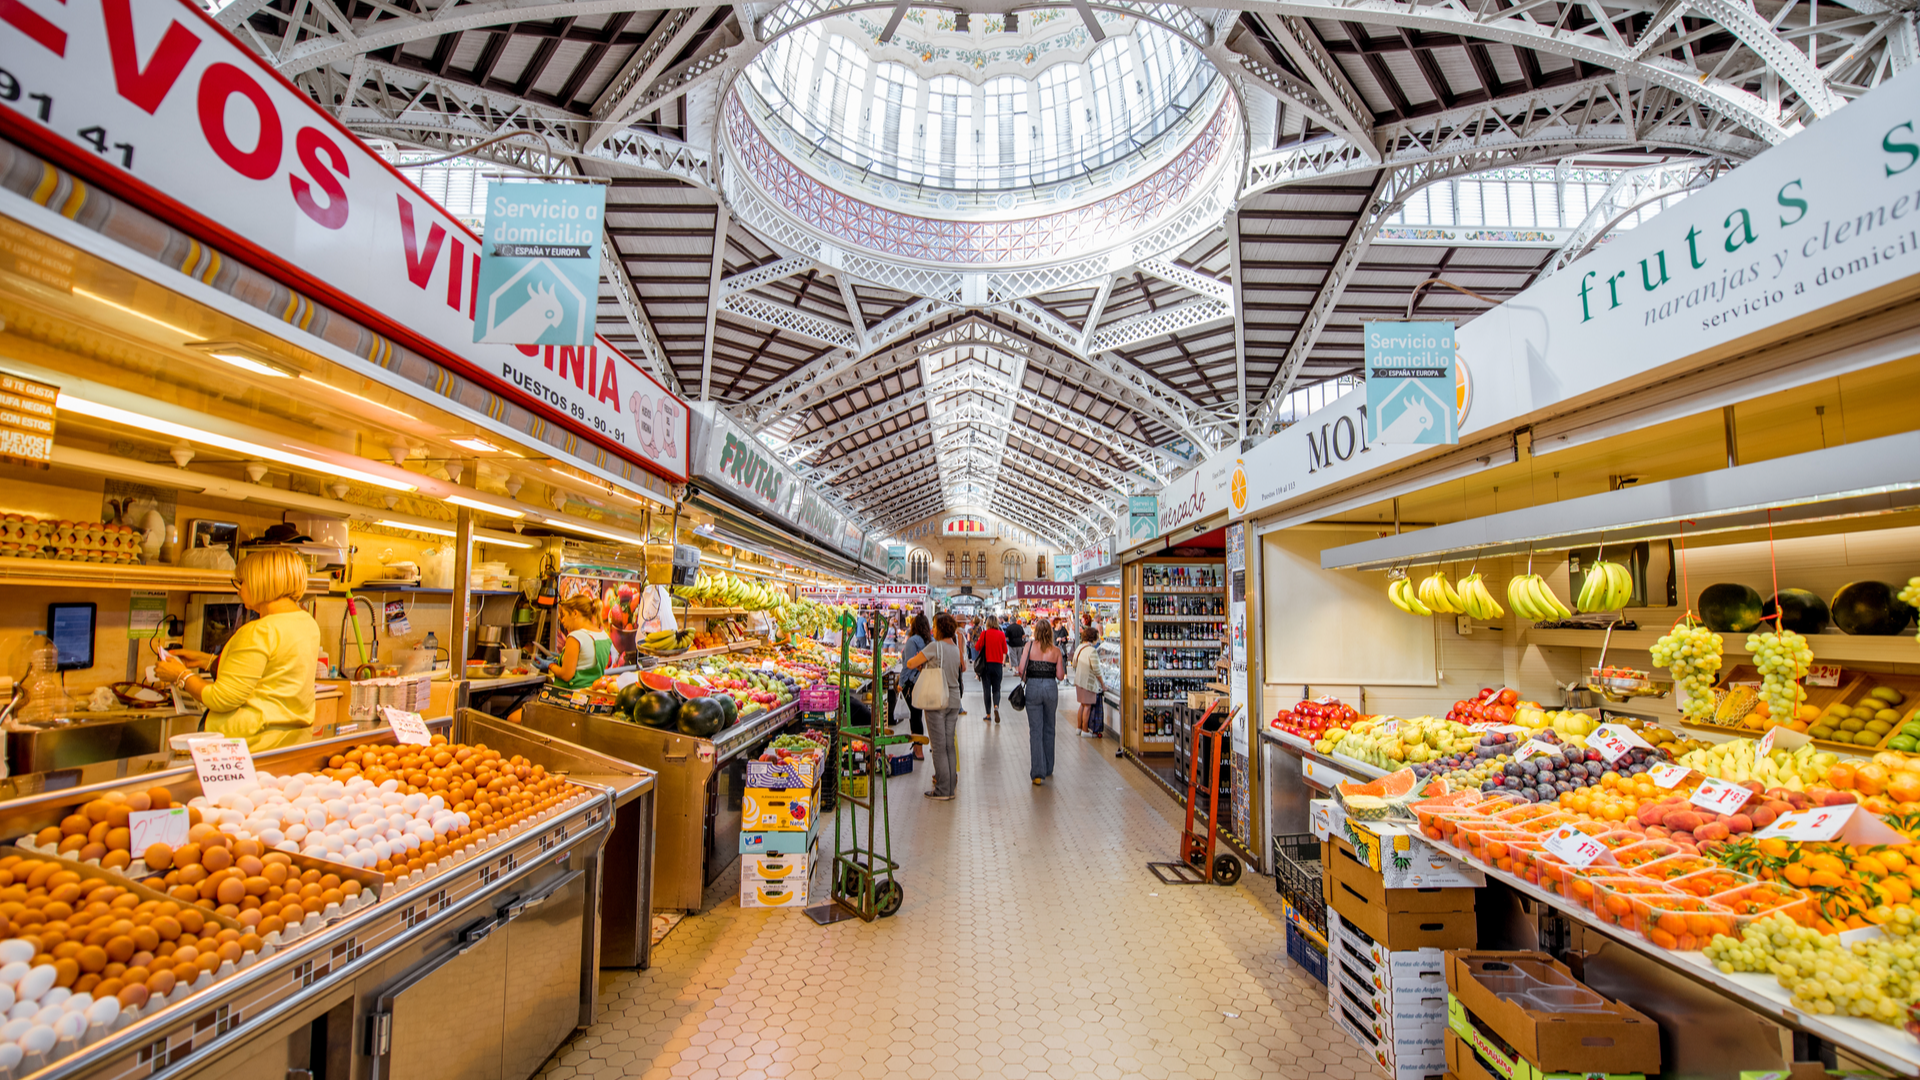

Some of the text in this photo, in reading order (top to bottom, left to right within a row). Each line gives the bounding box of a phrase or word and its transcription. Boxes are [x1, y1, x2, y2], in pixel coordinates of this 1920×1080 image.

[78, 125, 134, 170] 41
[493, 196, 598, 220] Servicio a
[494, 221, 593, 244] domicilio
[515, 246, 581, 257] ESPAÑA Y EUROPA
[1577, 178, 1808, 324] frutas
[1644, 260, 1760, 326] naranjas
[1772, 247, 1790, 280] y
[1702, 230, 1919, 331] servicio a domicil
[396, 192, 621, 415] VINIA
[1370, 333, 1450, 349] Servicio a
[1373, 351, 1449, 367] domicilio
[1388, 369, 1411, 377] ESPAÑA
[2, 377, 55, 400] SI TE GUSTA
[21, 399, 53, 416] NEGRA
[503, 362, 567, 411] PUESTOS
[571, 402, 584, 420] 89
[594, 416, 606, 433] 90
[614, 428, 625, 444] 91
[0, 412, 51, 431] CON ESTOS
[720, 431, 783, 504] FRUTAS
[1160, 470, 1206, 531] mercado
[1261, 490, 1275, 501] Puestos
[878, 585, 927, 594] FRUTAS
[1024, 584, 1081, 596] PUCHADE
[210, 761, 245, 772] 2,10 €
[202, 773, 245, 783] DOCENA
[1716, 788, 1746, 804] 1'95
